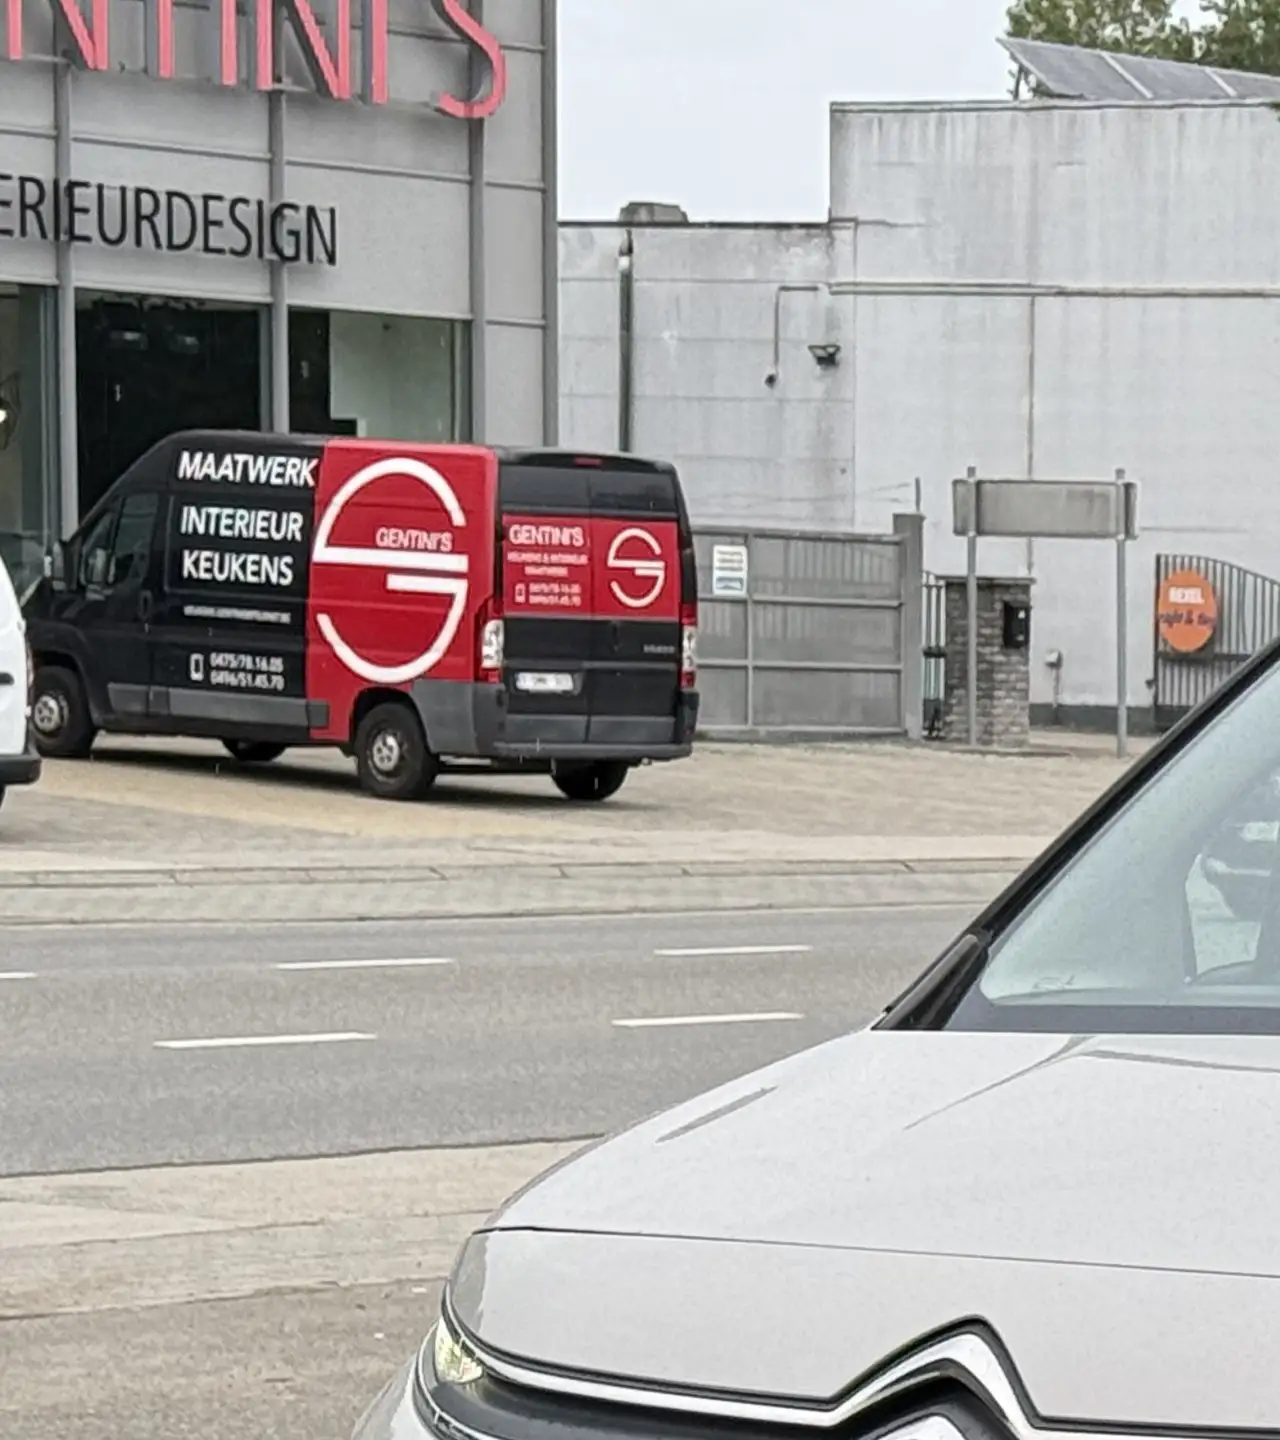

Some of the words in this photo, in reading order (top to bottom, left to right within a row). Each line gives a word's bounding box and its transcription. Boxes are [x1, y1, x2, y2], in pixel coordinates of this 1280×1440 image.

[178, 451, 319, 487] MAATWERK
[180, 506, 303, 542] INTERIEUR
[182, 549, 294, 586] KEUKENS
